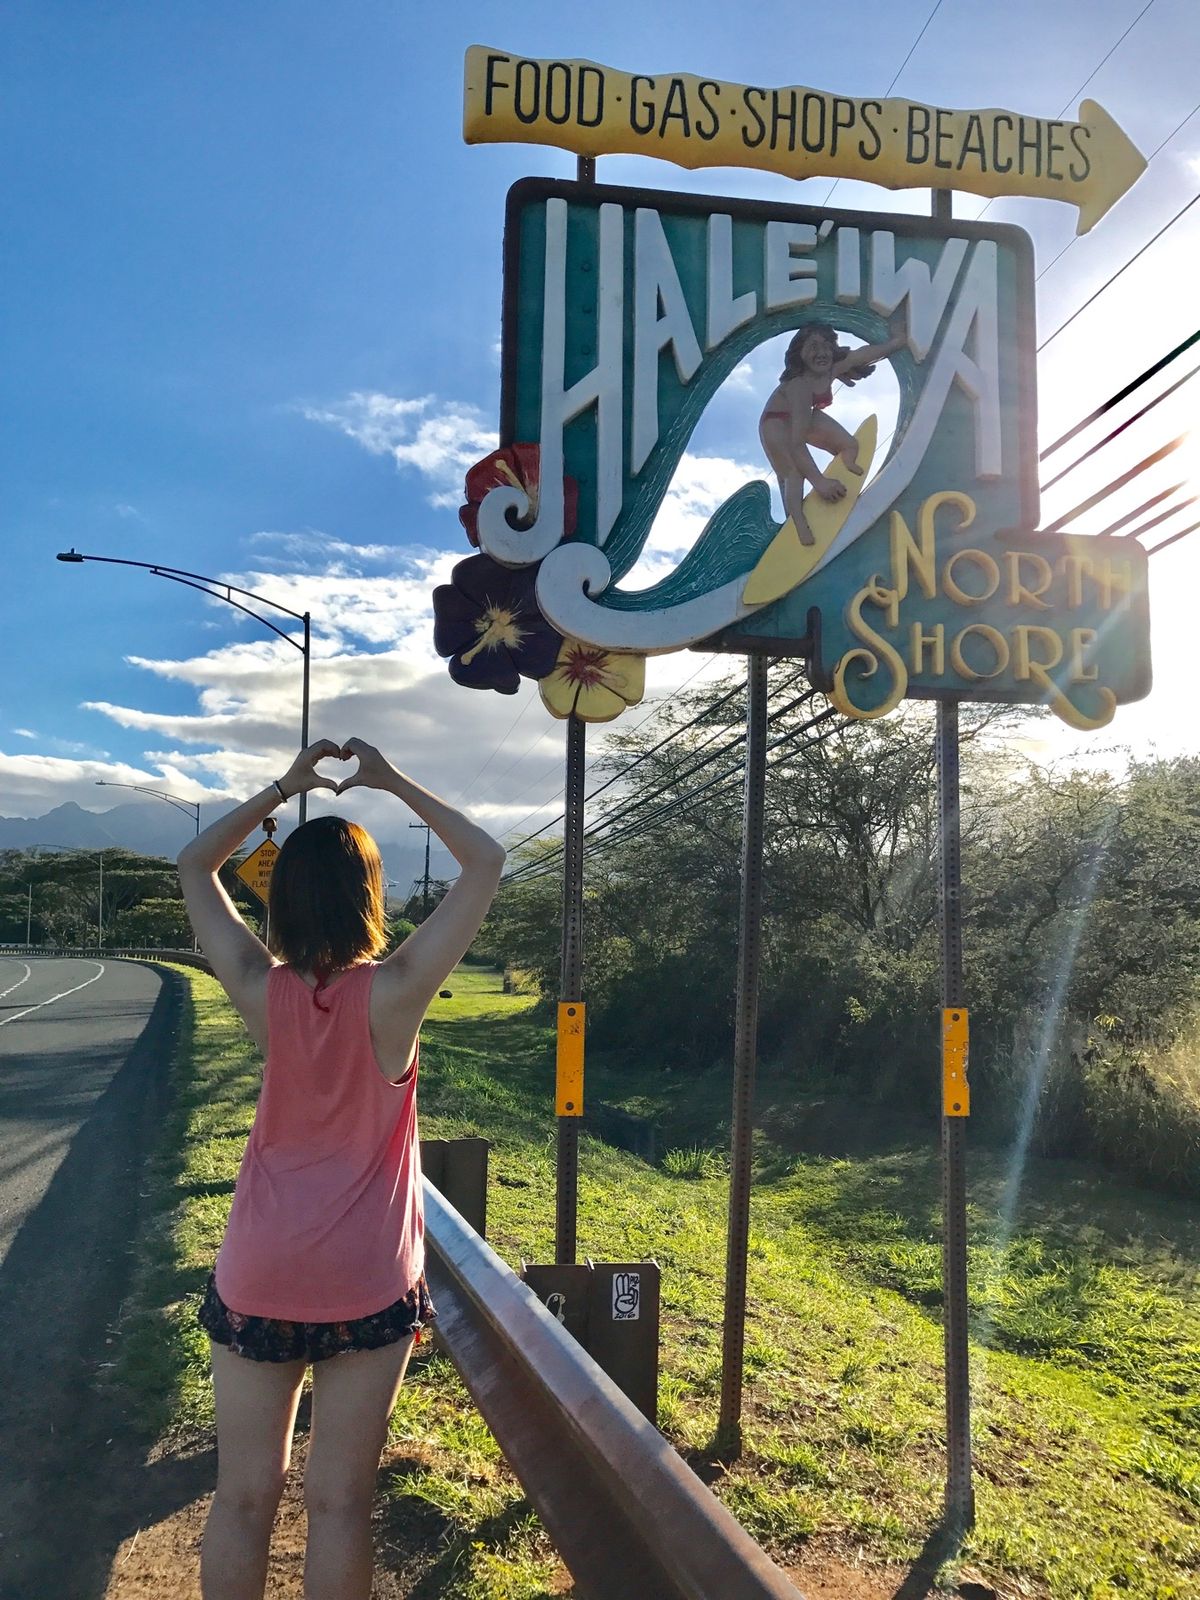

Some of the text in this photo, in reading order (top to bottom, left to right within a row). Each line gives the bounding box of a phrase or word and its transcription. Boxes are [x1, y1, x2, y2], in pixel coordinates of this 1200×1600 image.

[484, 54, 1092, 183] FOOD GAS SHOPS BEACHES
[889, 490, 1132, 611] NORTH
[833, 574, 1118, 731] SHORE
